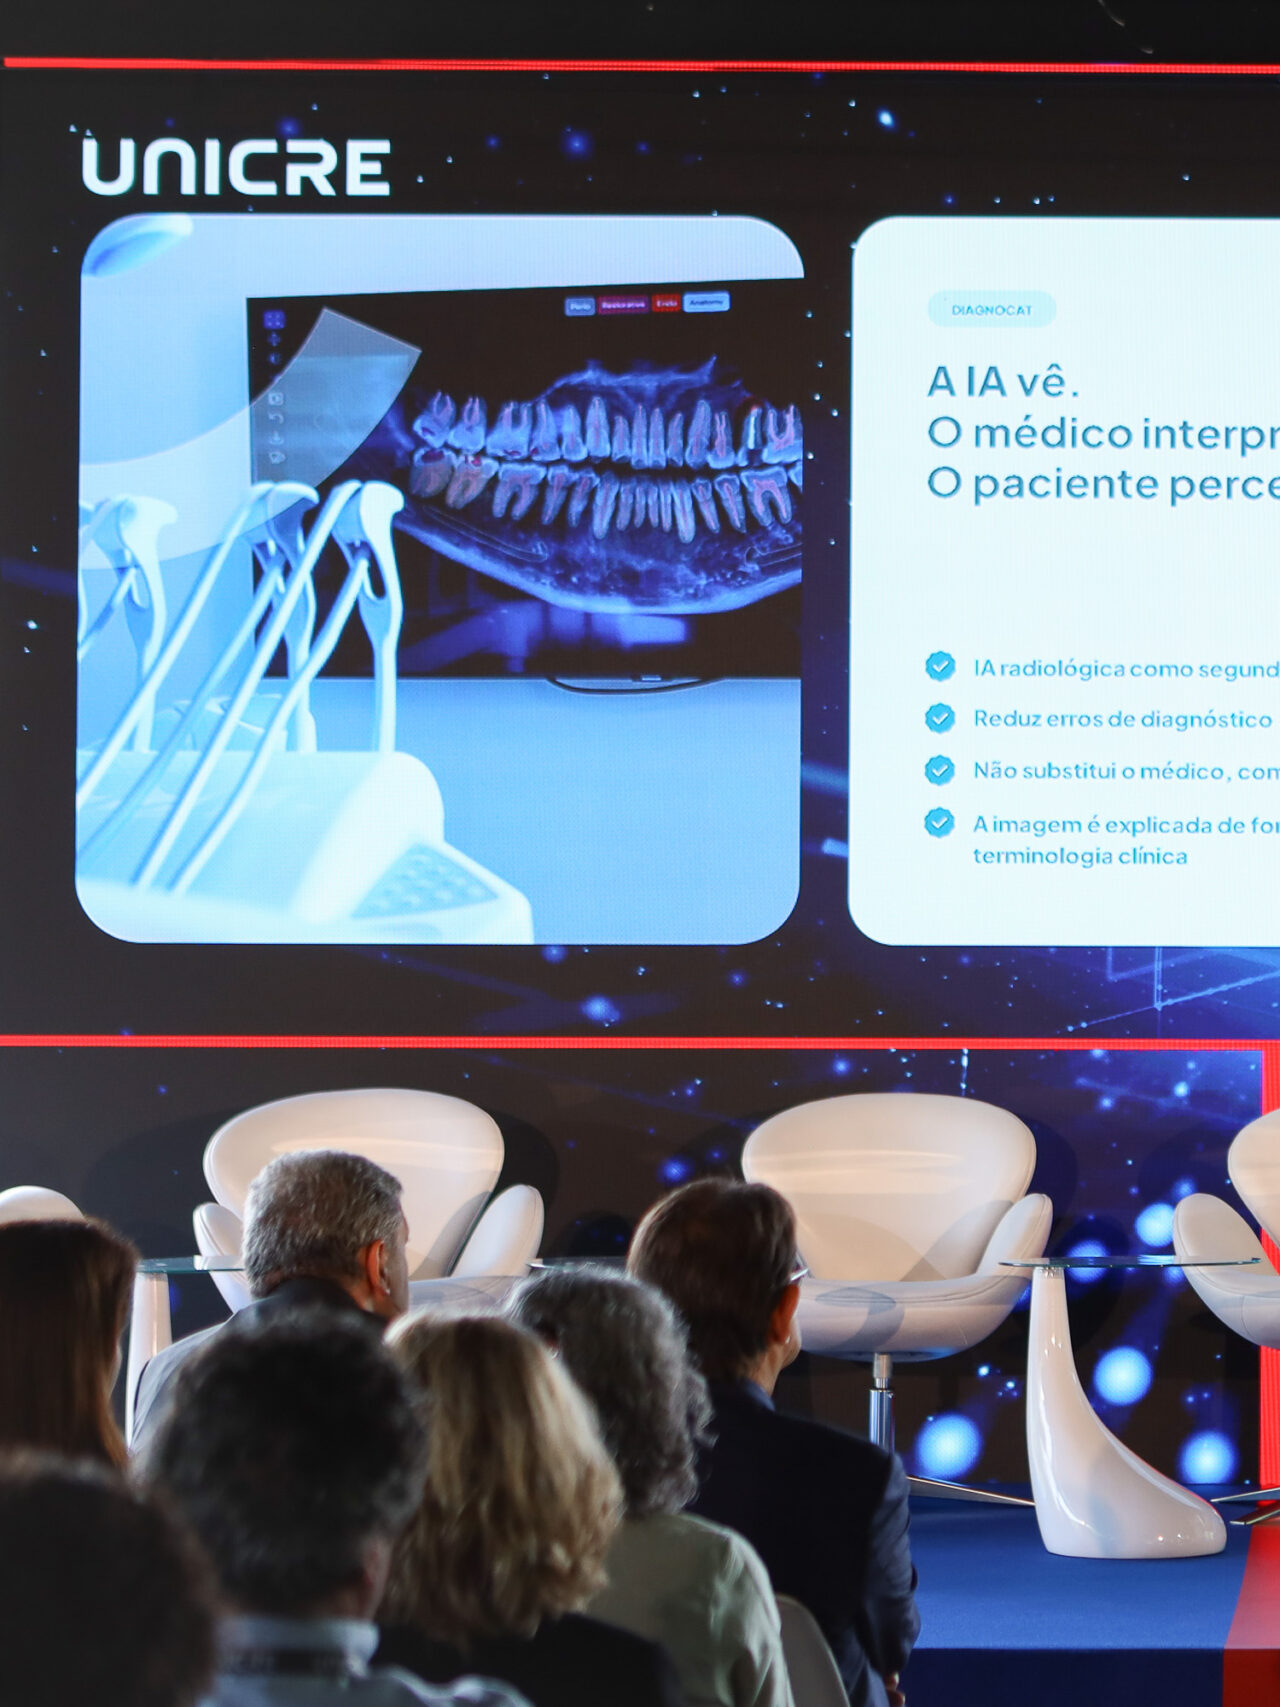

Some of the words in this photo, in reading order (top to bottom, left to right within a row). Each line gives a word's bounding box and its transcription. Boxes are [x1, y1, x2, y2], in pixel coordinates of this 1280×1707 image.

[81, 137, 391, 196] UNICRE
[951, 304, 1032, 316] DIAGNOCAT
[927, 365, 957, 397] A
[967, 365, 1007, 397] IA
[1016, 362, 1079, 398] vê.
[927, 415, 963, 449] O
[974, 413, 1133, 449] médico
[927, 465, 962, 499] O
[974, 466, 1159, 507] paciente
[974, 658, 997, 678] IA
[1000, 657, 1126, 683] radiológica
[1129, 663, 1194, 678] como
[974, 708, 1042, 727] Reduz
[1046, 713, 1104, 728] erros
[1107, 710, 1136, 728] de
[1140, 708, 1273, 732] diagnóstico
[973, 760, 1018, 779] Não
[1022, 761, 1117, 780] substitui
[1121, 766, 1136, 780] o
[1139, 760, 1232, 783] médico,
[973, 814, 989, 833] A
[992, 815, 1083, 838] imagem
[1087, 814, 1101, 833] é
[1105, 815, 1213, 838] explicada
[1217, 816, 1246, 834] de
[973, 846, 1113, 870] terminologia
[1117, 845, 1188, 866] clínica
